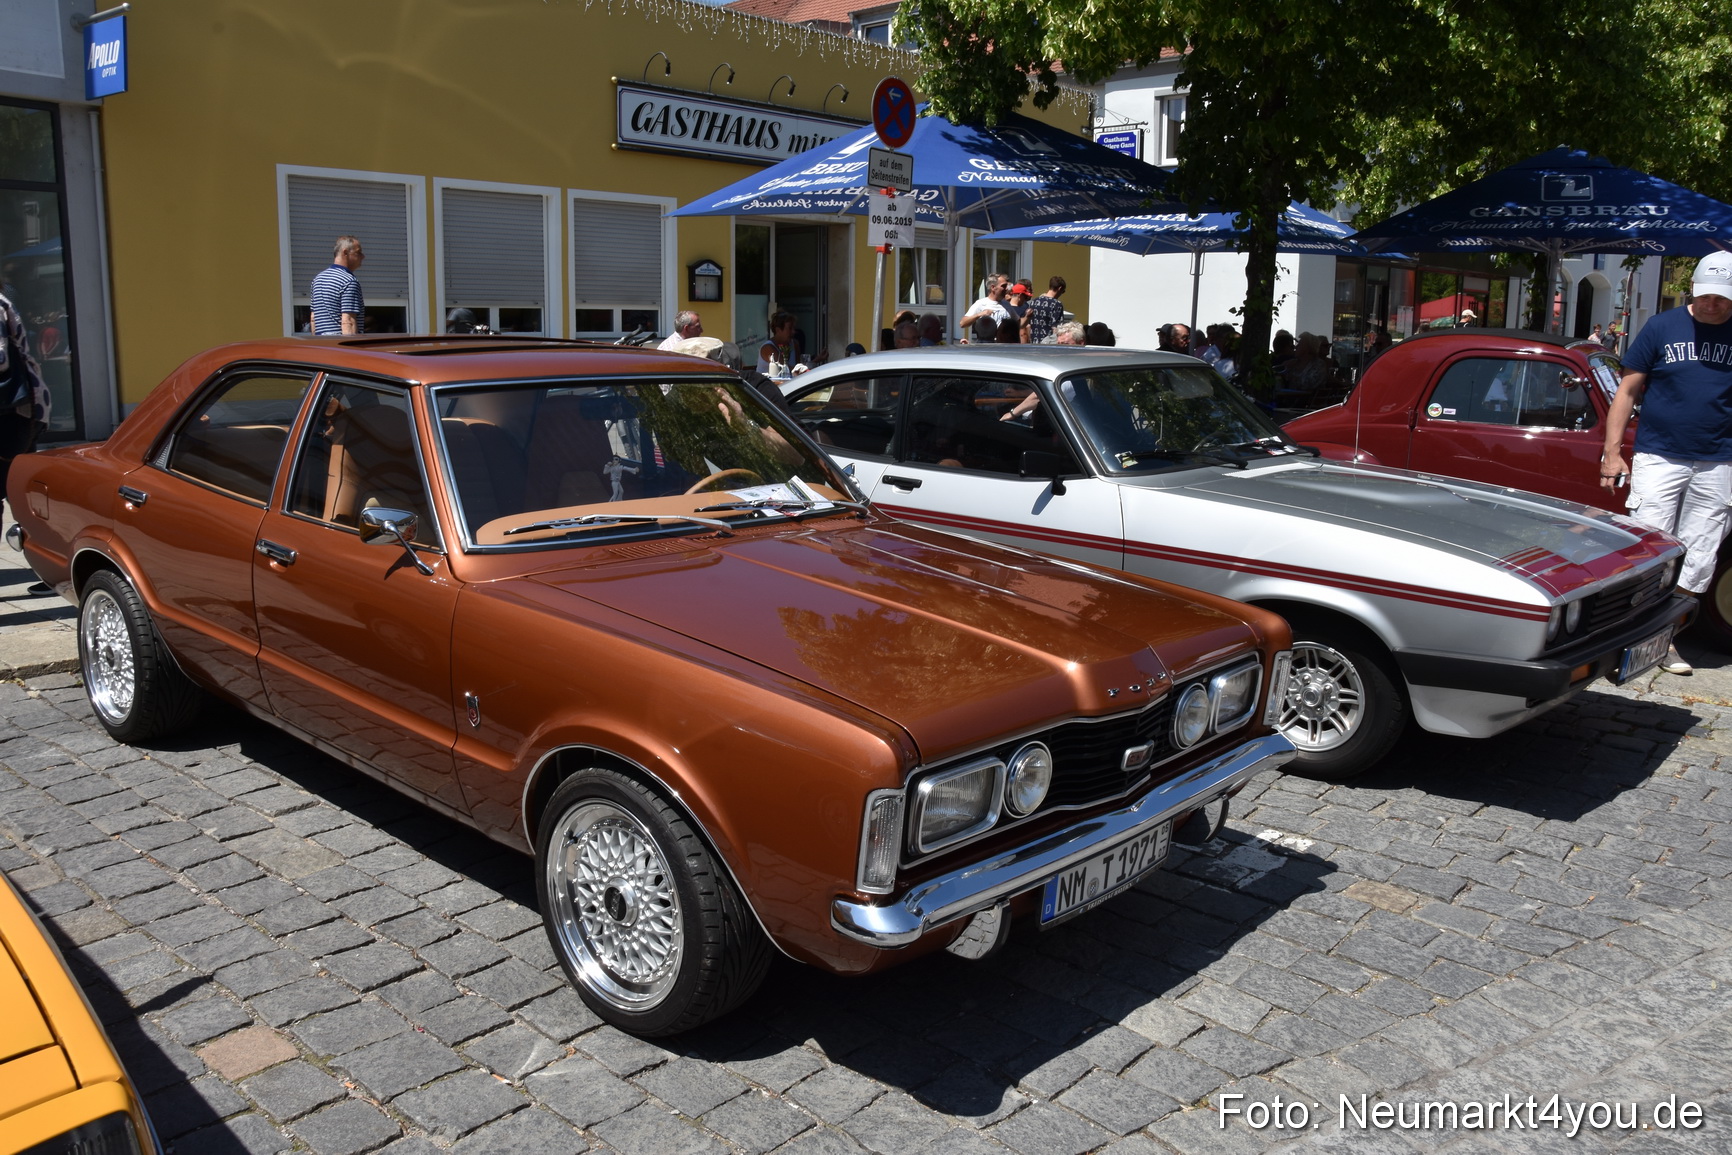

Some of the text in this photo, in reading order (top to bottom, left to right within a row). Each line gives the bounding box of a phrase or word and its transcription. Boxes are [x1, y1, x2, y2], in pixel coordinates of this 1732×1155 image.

[101, 66, 117, 78] OPTIK
[631, 101, 782, 149] GASTHAUS
[879, 158, 903, 171] auf dem
[871, 168, 909, 185] Seitenstreifen
[887, 202, 897, 212] ab
[1469, 204, 1671, 217] GANSBRÄU
[871, 215, 912, 226] 09.06.2019
[1562, 220, 1621, 232] guter
[1620, 218, 1718, 232] Schluck
[1057, 866, 1087, 912] NM
[1045, 903, 1052, 915] D
